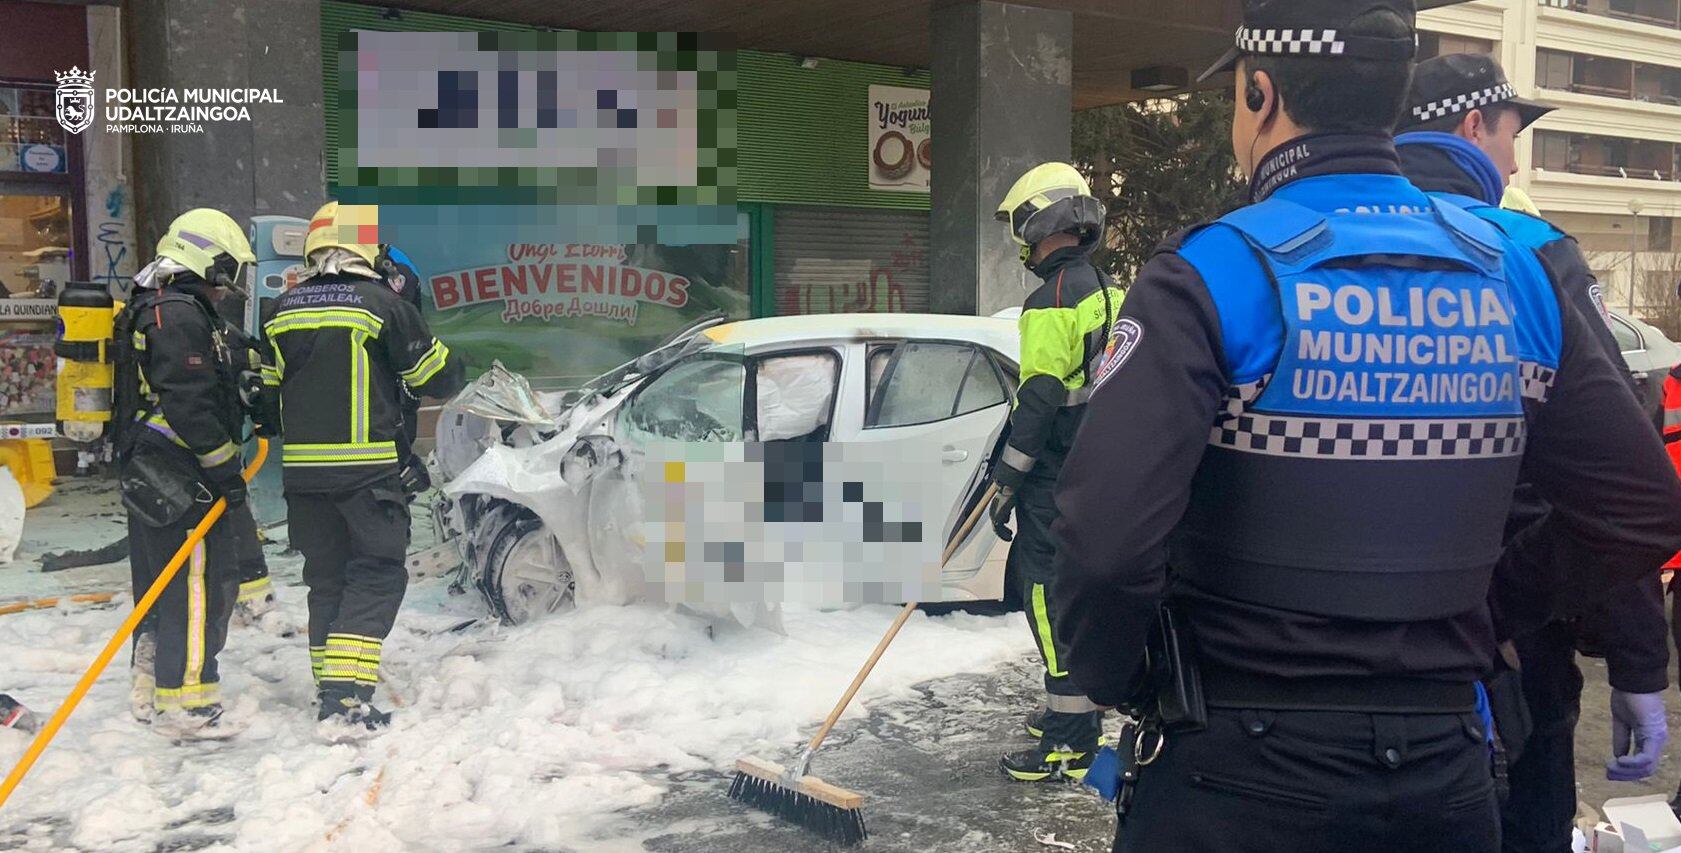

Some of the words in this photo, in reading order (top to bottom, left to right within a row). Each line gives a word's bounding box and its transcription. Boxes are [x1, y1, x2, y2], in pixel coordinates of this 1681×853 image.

[908, 121, 930, 134] Bulg
[1261, 144, 1310, 180] MUNICIPAL
[288, 283, 356, 295] BOMBEROS
[431, 264, 688, 308] BIENVENIDOS
[0, 304, 11, 315] LA
[13, 304, 58, 315] QUINDIAN
[283, 293, 363, 306] UHILTZAILEAK
[1296, 283, 1511, 328] POLICIA
[1298, 330, 1515, 365] MUNICIPAL
[1292, 369, 1513, 404] UDALTZAINGOA
[35, 427, 53, 435] 092
